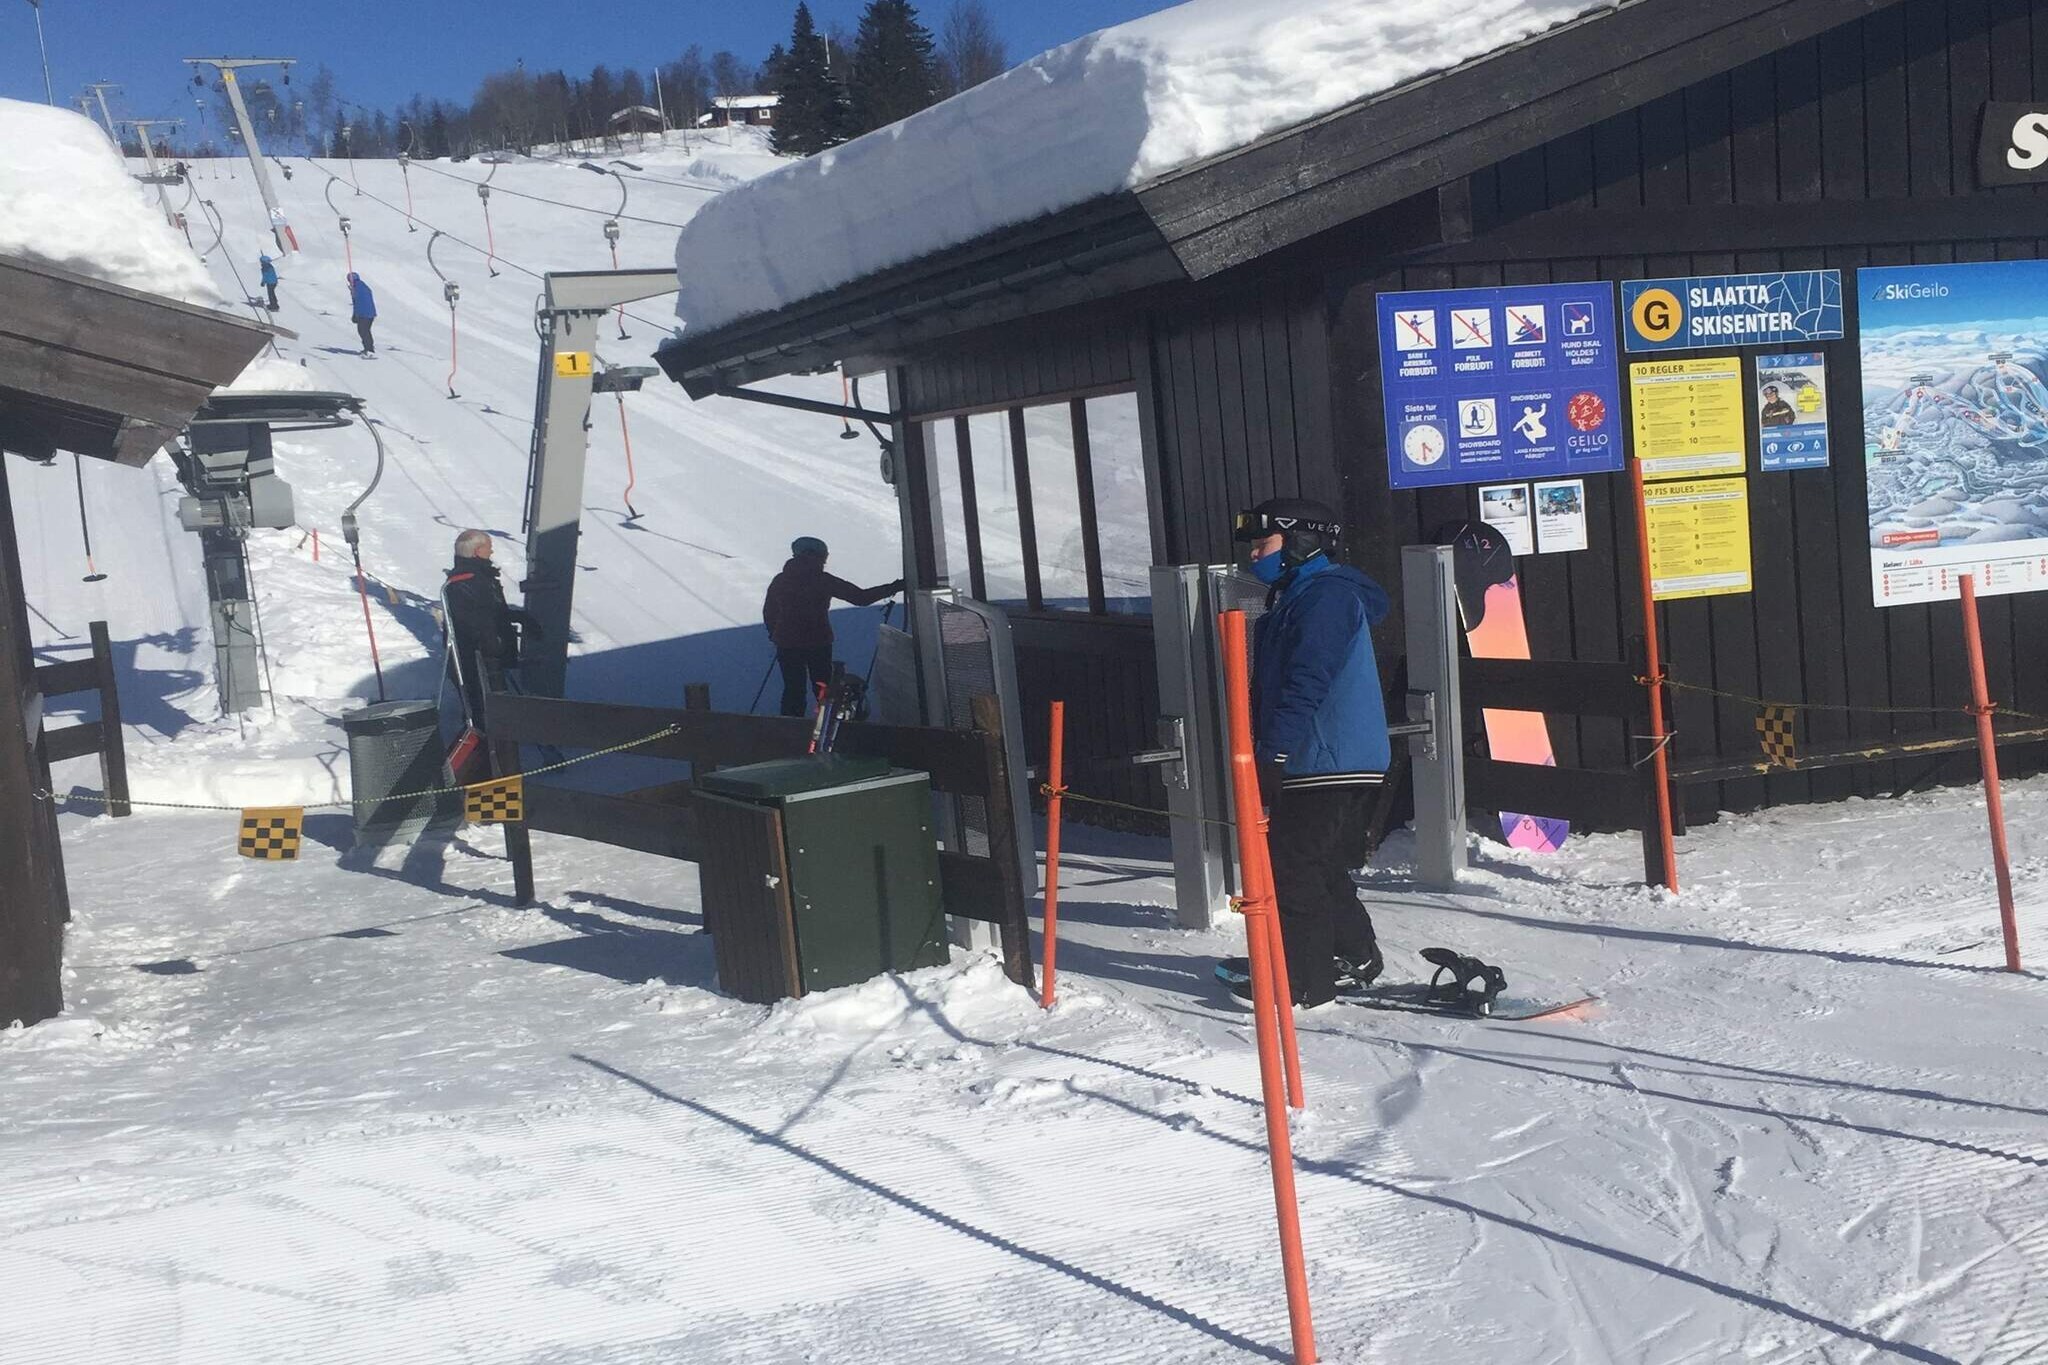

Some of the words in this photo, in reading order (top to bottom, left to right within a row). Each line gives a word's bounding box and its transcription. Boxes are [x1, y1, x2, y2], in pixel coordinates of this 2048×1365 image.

[1690, 285, 1770, 308] SLAATTA
[1886, 282, 1949, 299] SkiGeilo
[1643, 300, 1670, 331] G
[1691, 312, 1793, 336] SKISENTER
[567, 354, 577, 370] 1
[1455, 361, 1493, 372] FORBUDT!
[1511, 358, 1546, 368] FORBUDT!
[1400, 366, 1438, 377] FORBUDT!
[1636, 366, 1648, 375] 10
[1650, 365, 1685, 374] REGLER
[1568, 434, 1608, 447] GEILO
[1644, 488, 1653, 496] 10
[1655, 487, 1668, 495] FIS
[1669, 485, 1694, 494] RULES
